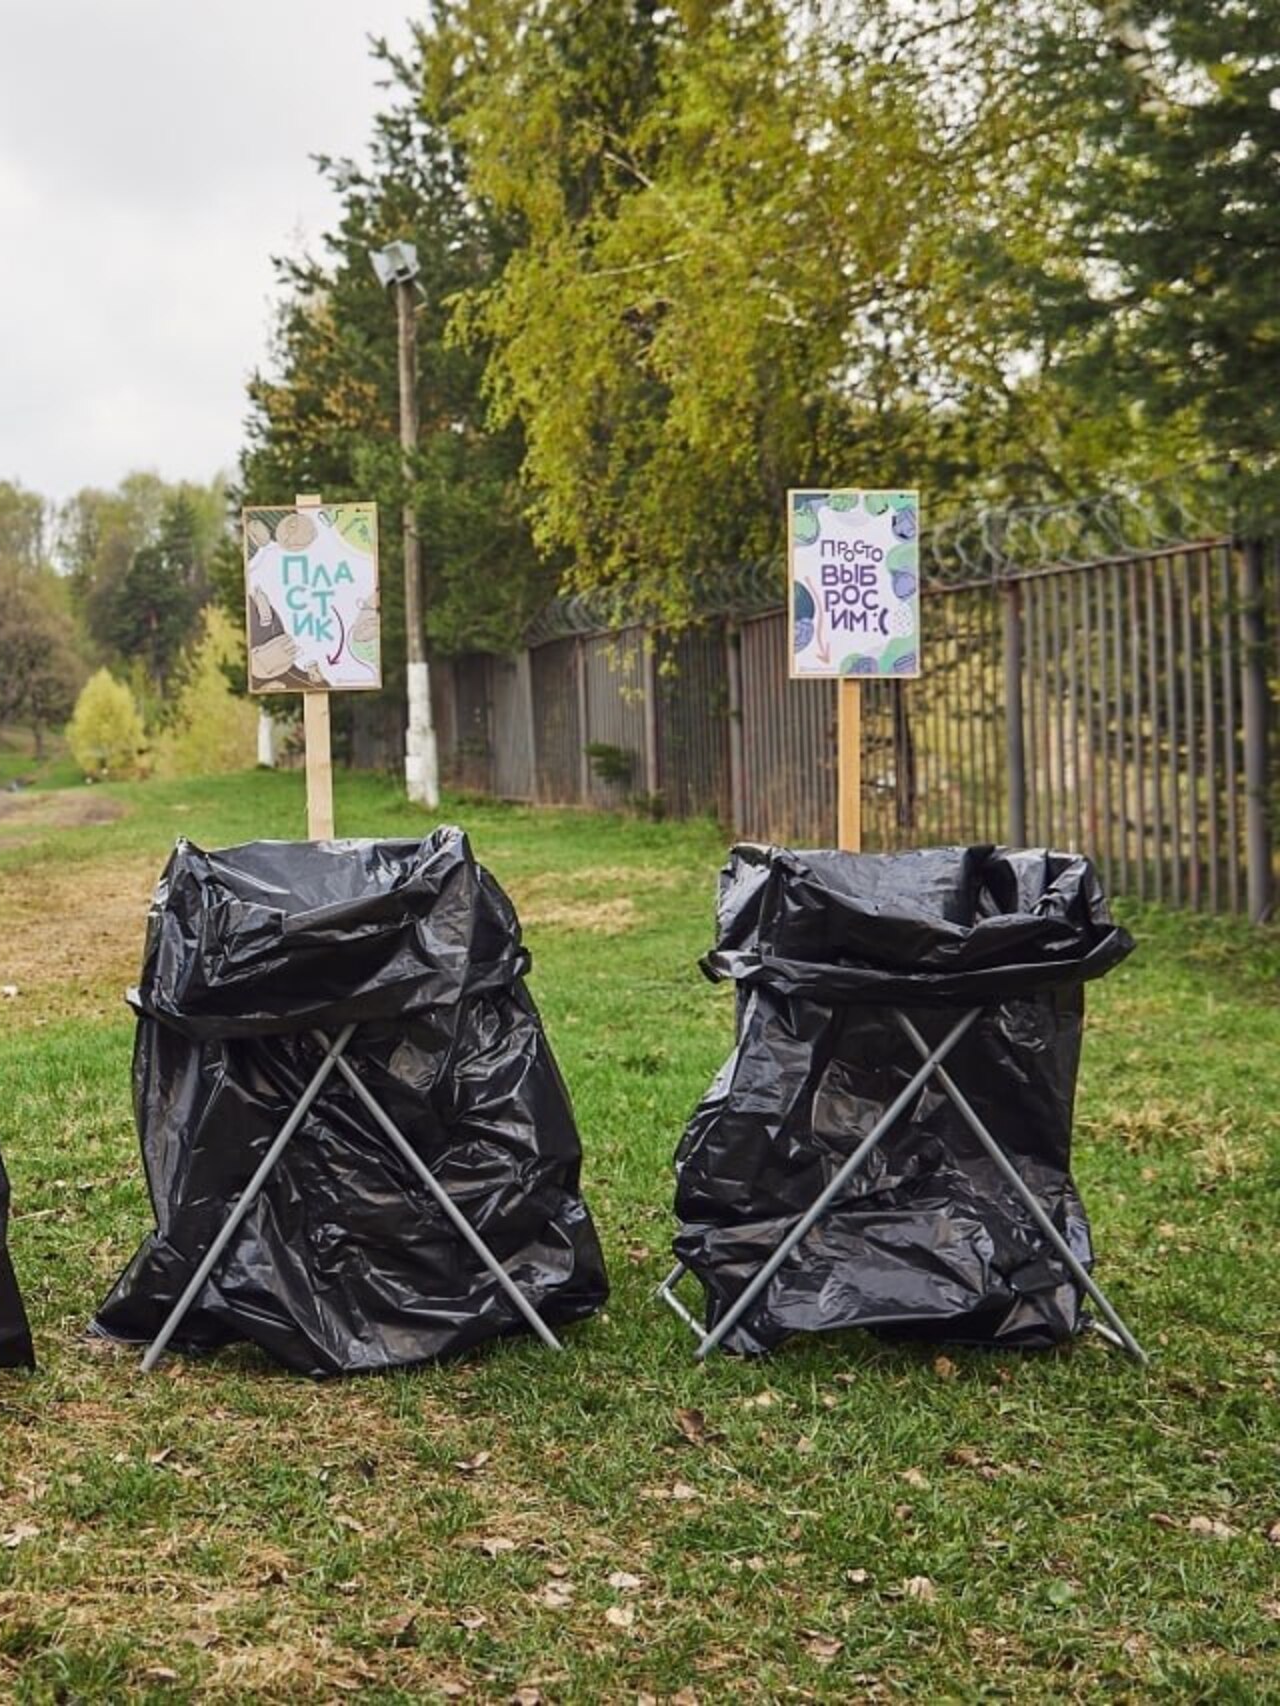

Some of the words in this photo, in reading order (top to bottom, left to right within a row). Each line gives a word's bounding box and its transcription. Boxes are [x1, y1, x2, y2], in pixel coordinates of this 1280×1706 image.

[282, 555, 354, 587] ПЛА
[821, 563, 877, 586] ВЫБ
[286, 586, 335, 617] СТ
[824, 584, 879, 612] РОС
[293, 612, 334, 642] ИК
